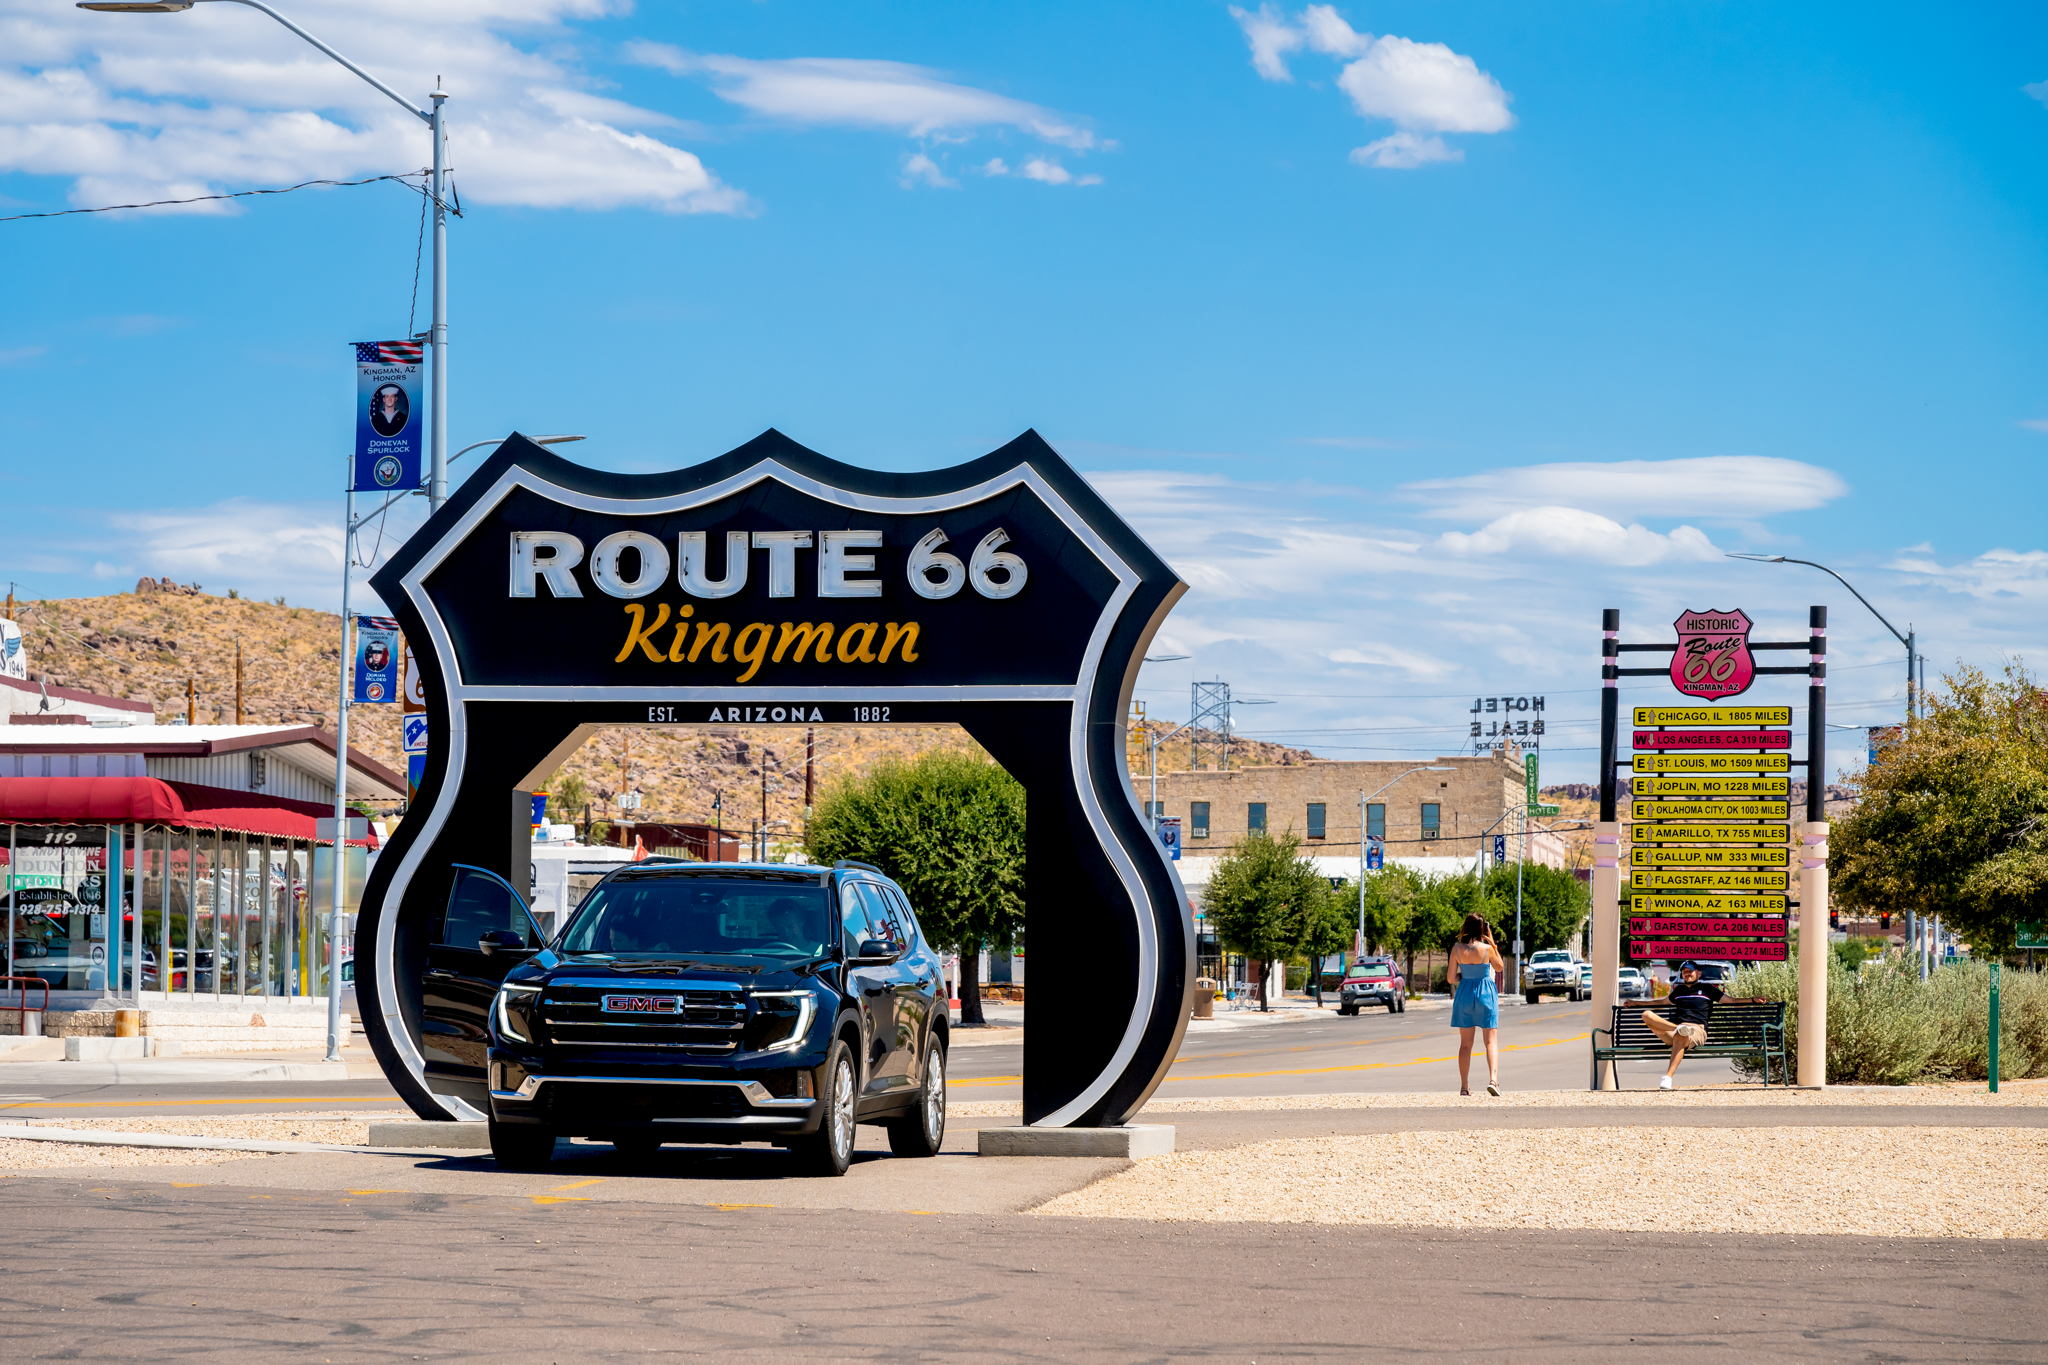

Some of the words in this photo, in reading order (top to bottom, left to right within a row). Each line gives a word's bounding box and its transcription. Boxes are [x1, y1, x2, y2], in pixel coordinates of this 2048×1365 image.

[405, 366, 416, 374] AZ
[373, 374, 407, 382] HONORS
[370, 440, 408, 448] DONEVAN
[367, 446, 410, 455] SPURLOCK
[509, 531, 883, 599] ROUTE
[906, 527, 1028, 600] 66
[1686, 618, 1740, 631] HISTORIC
[614, 603, 920, 683] Kingman
[1684, 636, 1742, 659] Route
[9, 660, 24, 678] 1946
[1683, 648, 1739, 683] 66
[1683, 683, 1726, 692] KINGMAN,
[1728, 683, 1740, 691] AZ
[648, 707, 678, 723] EST.
[709, 707, 825, 723] ARIZONA
[853, 707, 891, 723] 1882
[1638, 711, 1646, 722] E
[1713, 712, 1723, 721] IL
[1728, 712, 1752, 721] 1805
[1755, 712, 1787, 721] MILES
[1635, 735, 1647, 745] W
[1658, 735, 1676, 744] LOS
[1726, 735, 1740, 744] CA
[1741, 735, 1757, 744] 319
[1758, 735, 1787, 744] MILES
[1637, 758, 1645, 768] E
[1711, 759, 1727, 768] MO
[1730, 759, 1752, 768] 1509
[1755, 759, 1786, 768] MILES
[1636, 781, 1645, 791] E
[1703, 782, 1721, 791] MO
[1724, 782, 1749, 791] 1228
[1752, 782, 1786, 791] MILES
[1529, 806, 1556, 816] HOTEL
[1636, 805, 1644, 815] E
[1656, 805, 1703, 814] OKLAHOMA
[1726, 805, 1738, 814] OK
[1741, 805, 1759, 814] 1003
[1761, 805, 1786, 814] MILES
[1635, 828, 1644, 838] E
[1716, 829, 1730, 838] TX
[1733, 829, 1750, 838] 755
[1753, 829, 1785, 838] MILES
[44, 832, 78, 845] 119
[32, 847, 61, 857] ANDY
[62, 846, 102, 857] DEVINE
[1635, 852, 1643, 862] E
[1705, 853, 1723, 861] NM
[1729, 853, 1748, 861] 333
[1751, 853, 1785, 861] MILES
[22, 859, 100, 873] DUNTON
[1635, 875, 1643, 885] E
[1718, 876, 1731, 885] AZ
[1734, 876, 1750, 885] 146
[1753, 876, 1784, 885] MILES
[19, 891, 74, 901] Established
[1634, 898, 1643, 908] E
[1706, 900, 1722, 908] AZ
[1728, 900, 1746, 908] 163
[1750, 900, 1784, 908] MILES
[1631, 921, 1644, 931] W
[1713, 923, 1728, 932] CA
[1731, 923, 1748, 932] 206
[1751, 923, 1784, 932] MILES
[1632, 945, 1643, 954] W
[1654, 946, 1671, 955] SAN
[1731, 946, 1743, 955] CA
[1744, 946, 1757, 955] 274
[1759, 946, 1784, 955] MILES
[607, 997, 676, 1012] GMC
